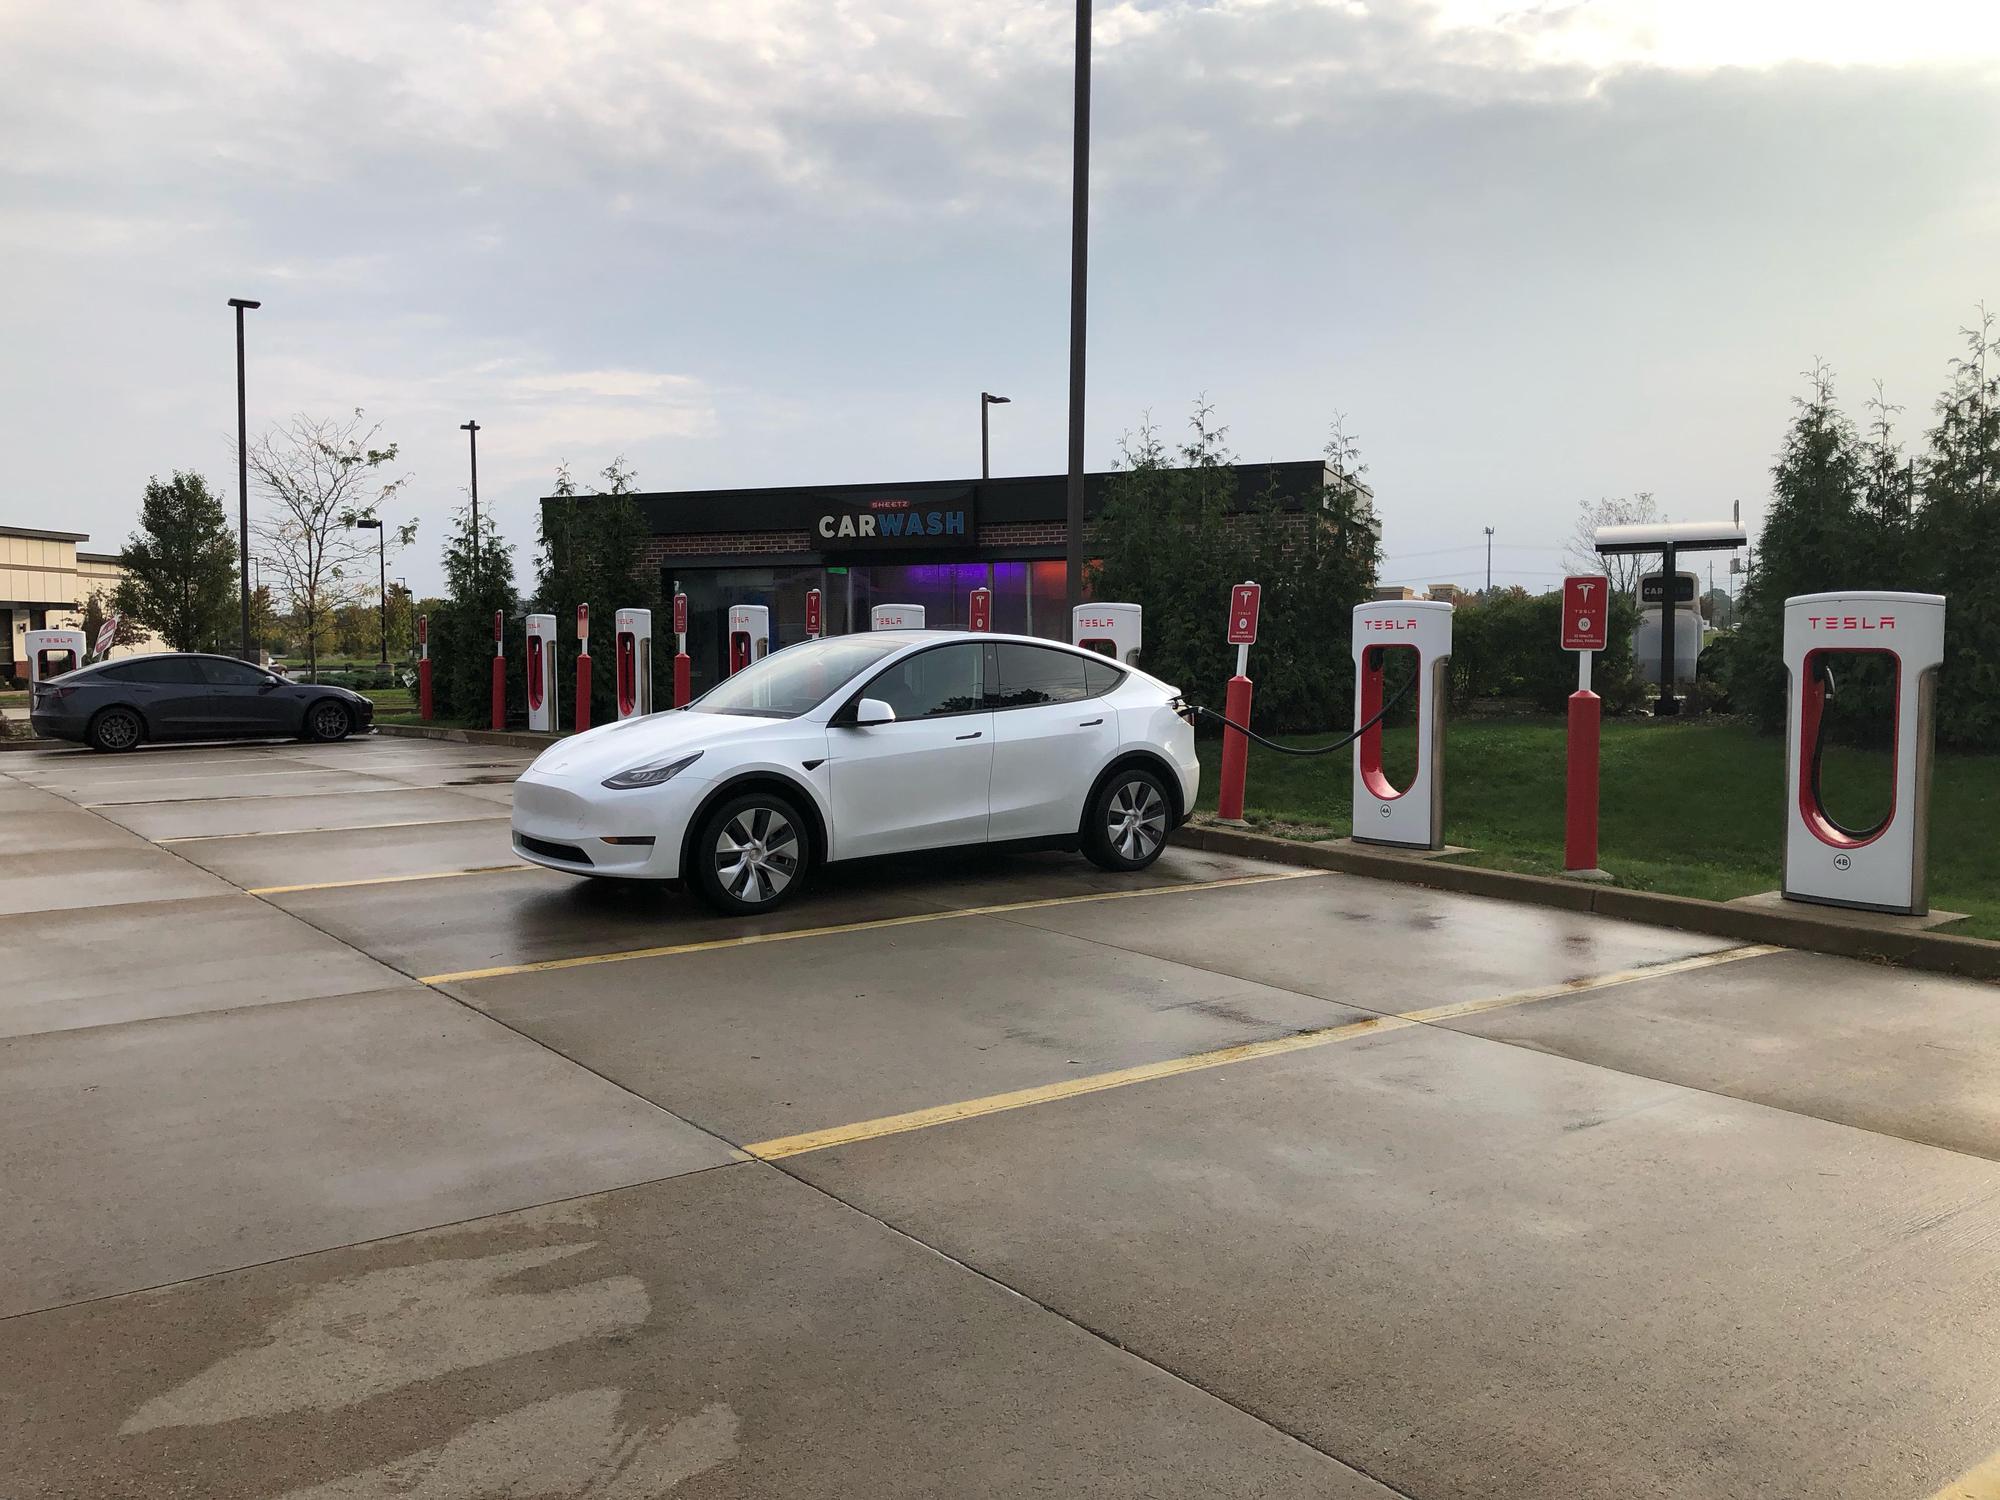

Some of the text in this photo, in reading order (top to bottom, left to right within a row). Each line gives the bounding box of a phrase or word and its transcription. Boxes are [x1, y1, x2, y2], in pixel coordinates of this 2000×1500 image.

[731, 616, 750, 624] TESLA
[876, 617, 902, 625] TESLA
[1079, 618, 1114, 628] TESLA
[1364, 619, 1417, 630] TESLA
[1808, 616, 1895, 629] TESLA
